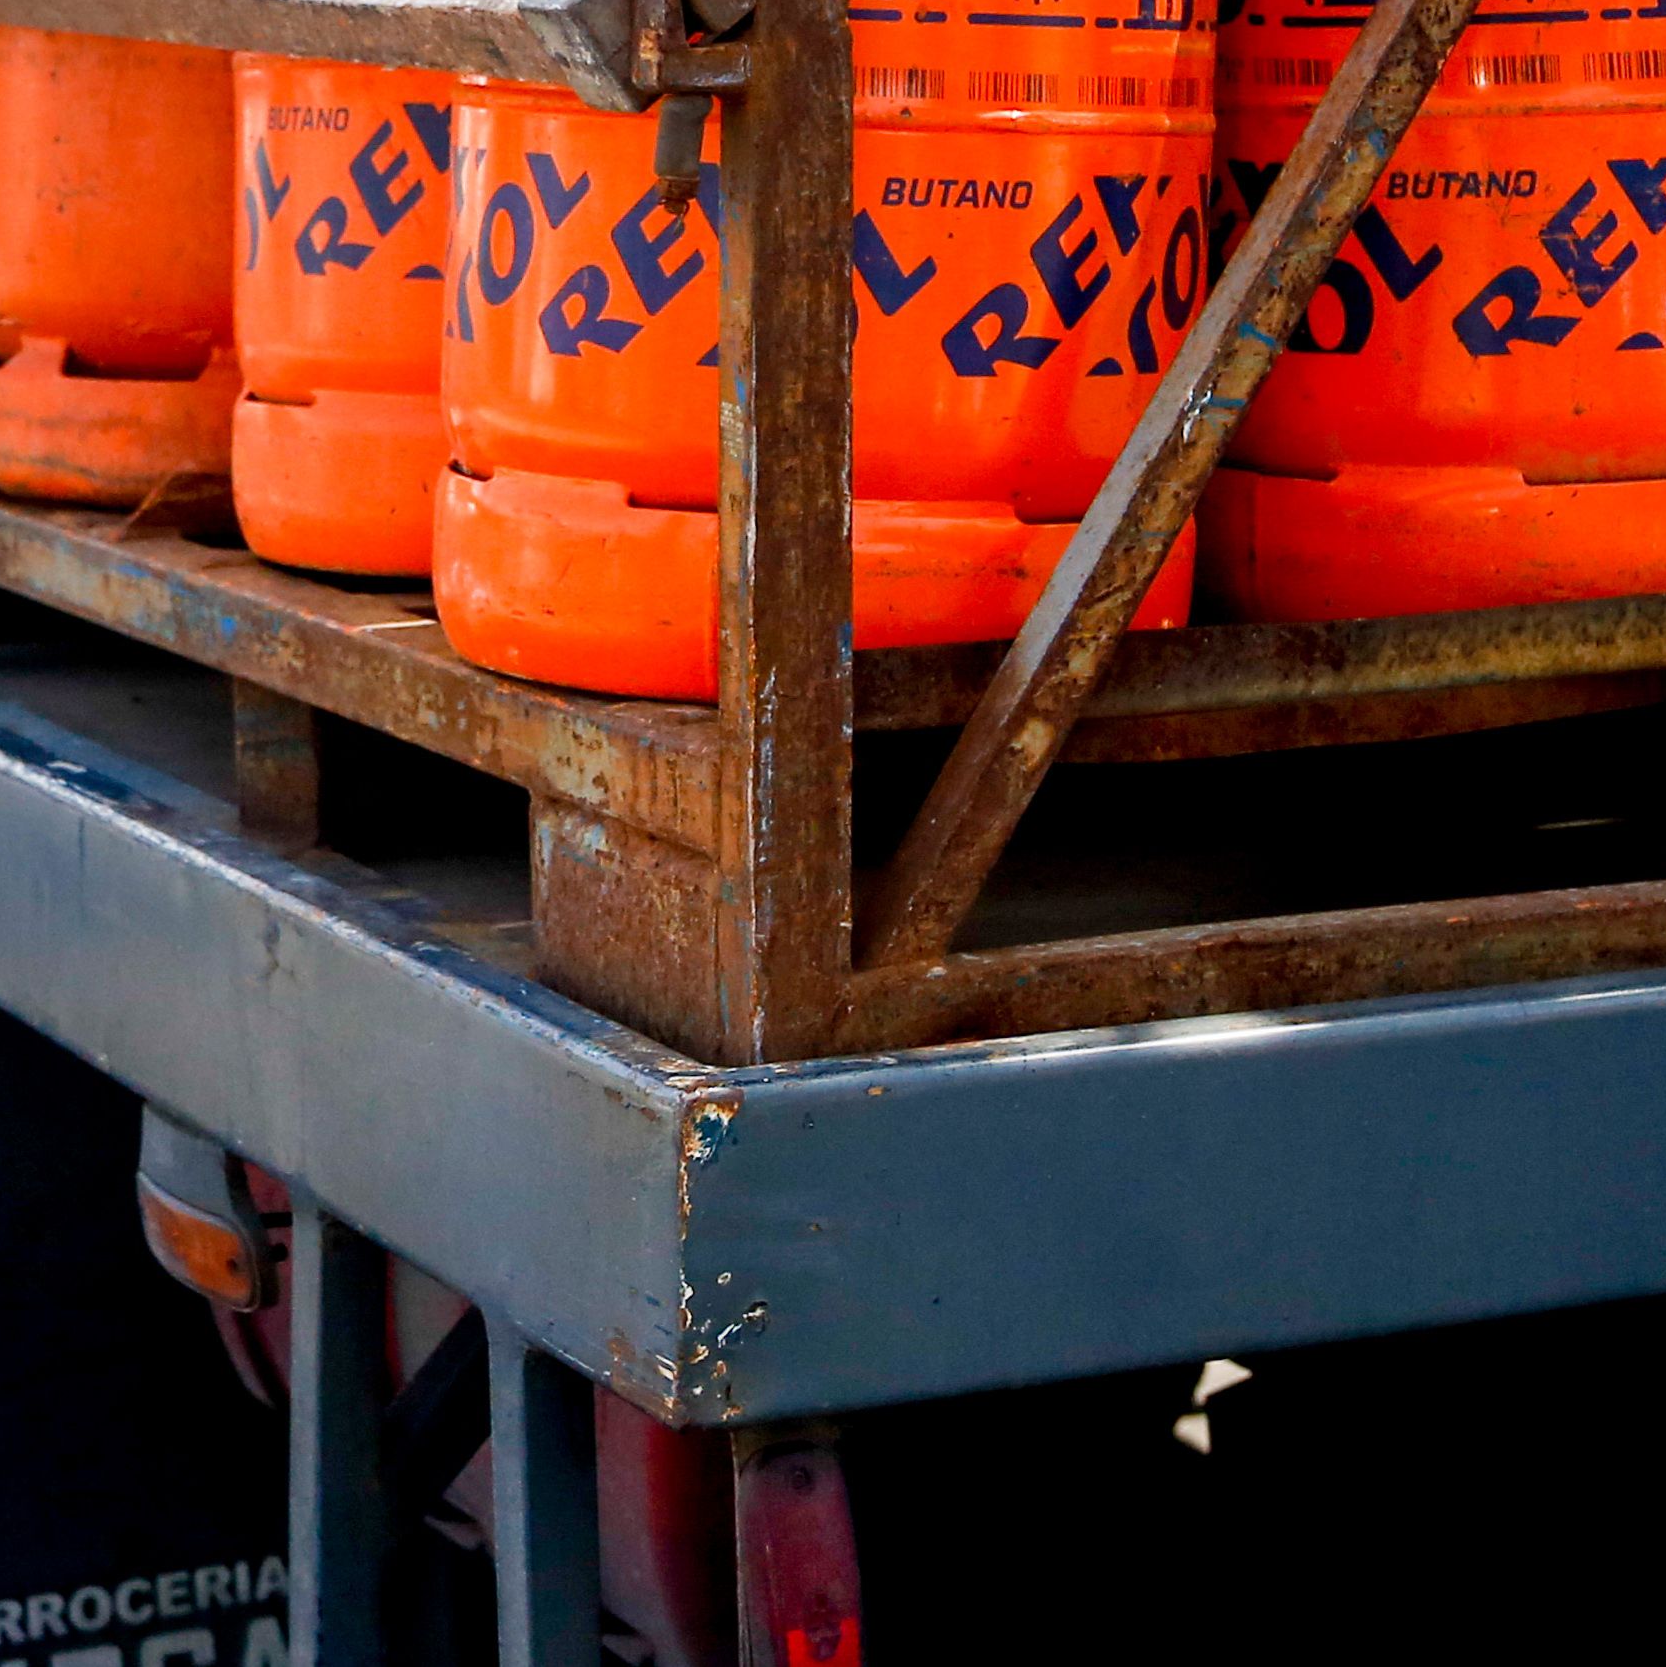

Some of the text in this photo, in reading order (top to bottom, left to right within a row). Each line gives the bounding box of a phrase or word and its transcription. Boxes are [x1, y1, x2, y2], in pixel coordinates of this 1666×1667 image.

[267, 105, 351, 132] BUTANO
[880, 176, 1034, 210] BUTANO
[1385, 169, 1539, 200] BUTANO
